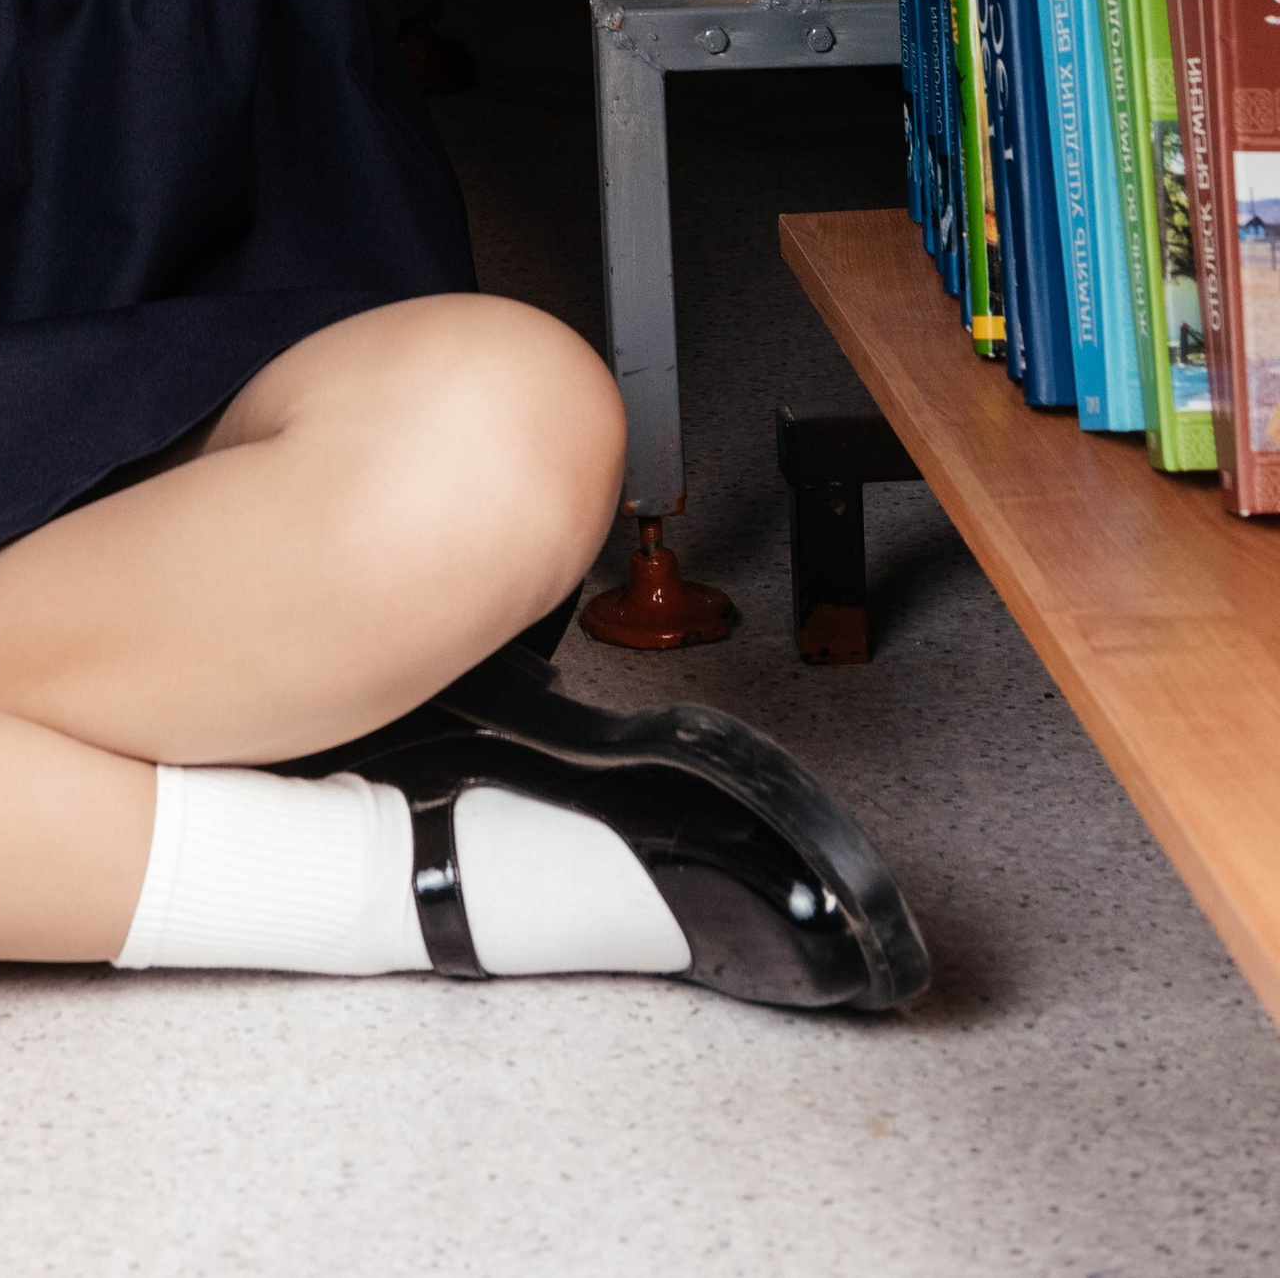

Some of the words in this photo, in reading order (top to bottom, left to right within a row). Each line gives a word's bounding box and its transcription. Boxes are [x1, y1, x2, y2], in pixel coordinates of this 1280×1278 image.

[1060, 64, 1085, 218] УШЕДШИХ
[1116, 112, 1134, 173] ИМЯ
[1186, 57, 1211, 191] ВРЕМЕНИ
[1126, 183, 1138, 222] ВО
[1073, 228, 1094, 343] ПАМЯТЬ
[1131, 232, 1148, 337] ЖИЗНЬ
[1199, 202, 1222, 331] ОТБЛЕСК
